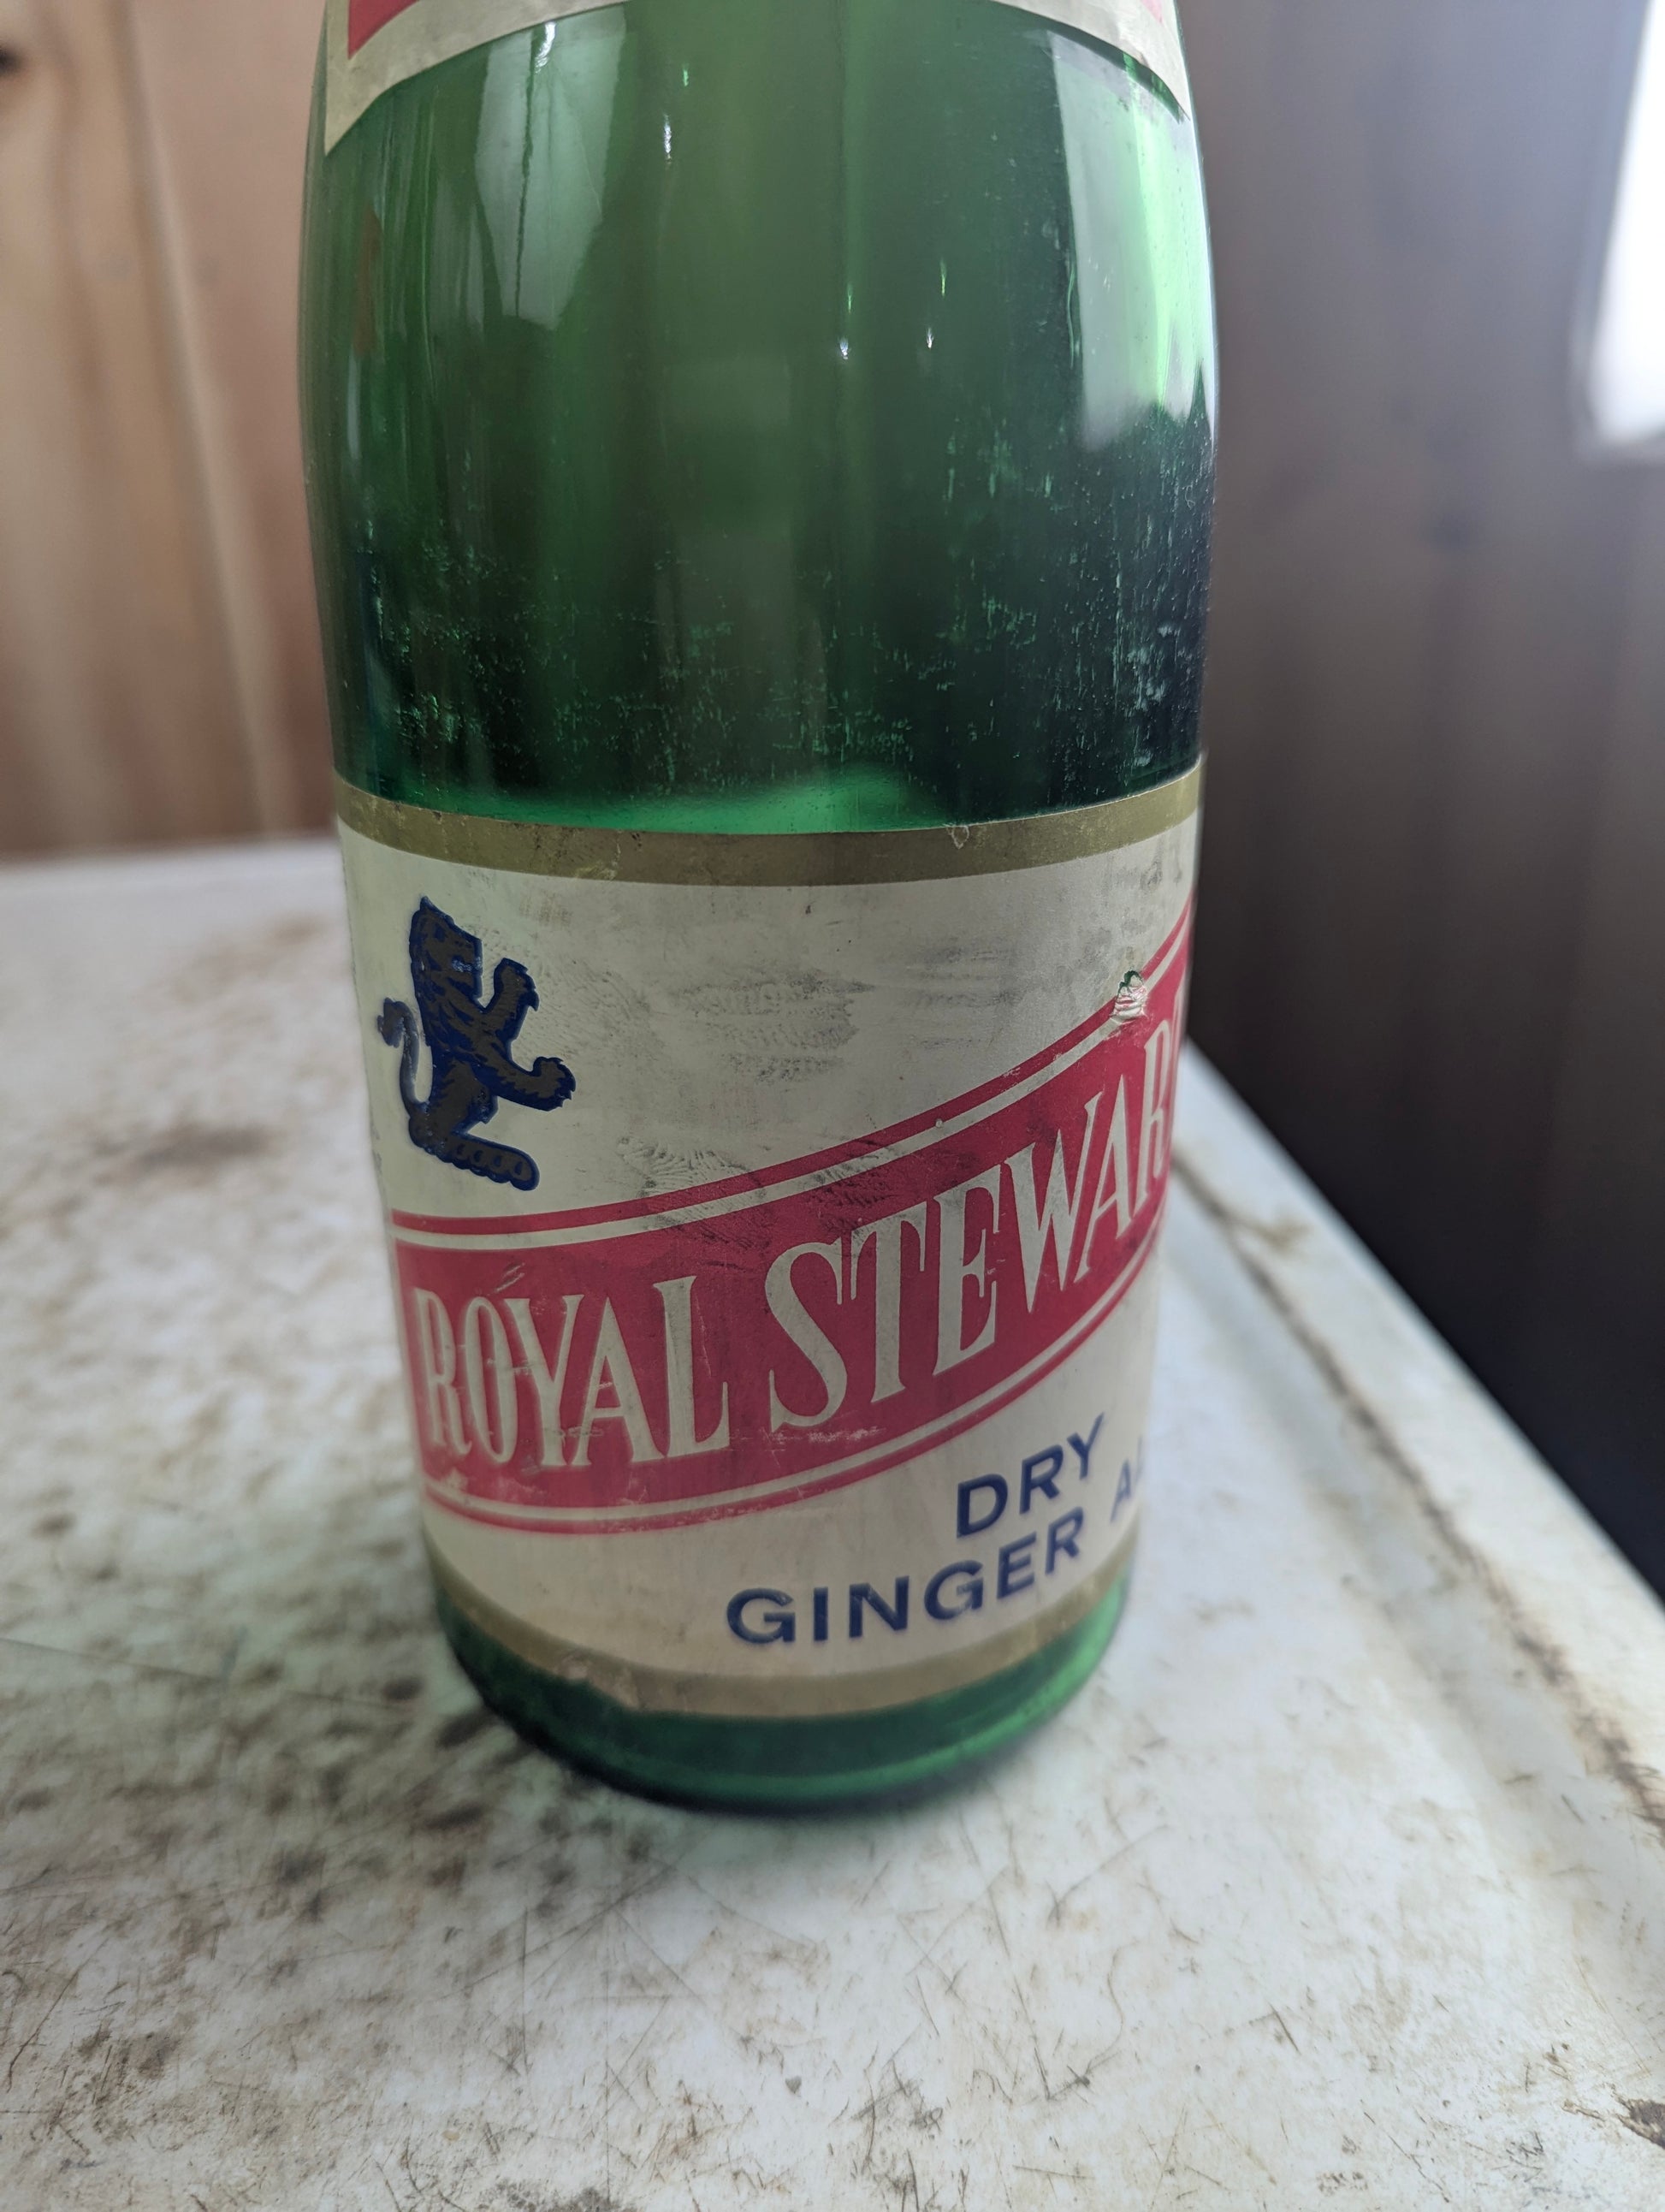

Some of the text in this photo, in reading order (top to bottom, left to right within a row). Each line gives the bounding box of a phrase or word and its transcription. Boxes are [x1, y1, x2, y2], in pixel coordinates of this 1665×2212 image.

[415, 1276, 730, 1467] ROYAL
[956, 1412, 1105, 1539] DRY
[726, 1506, 1085, 1645] GINGER
